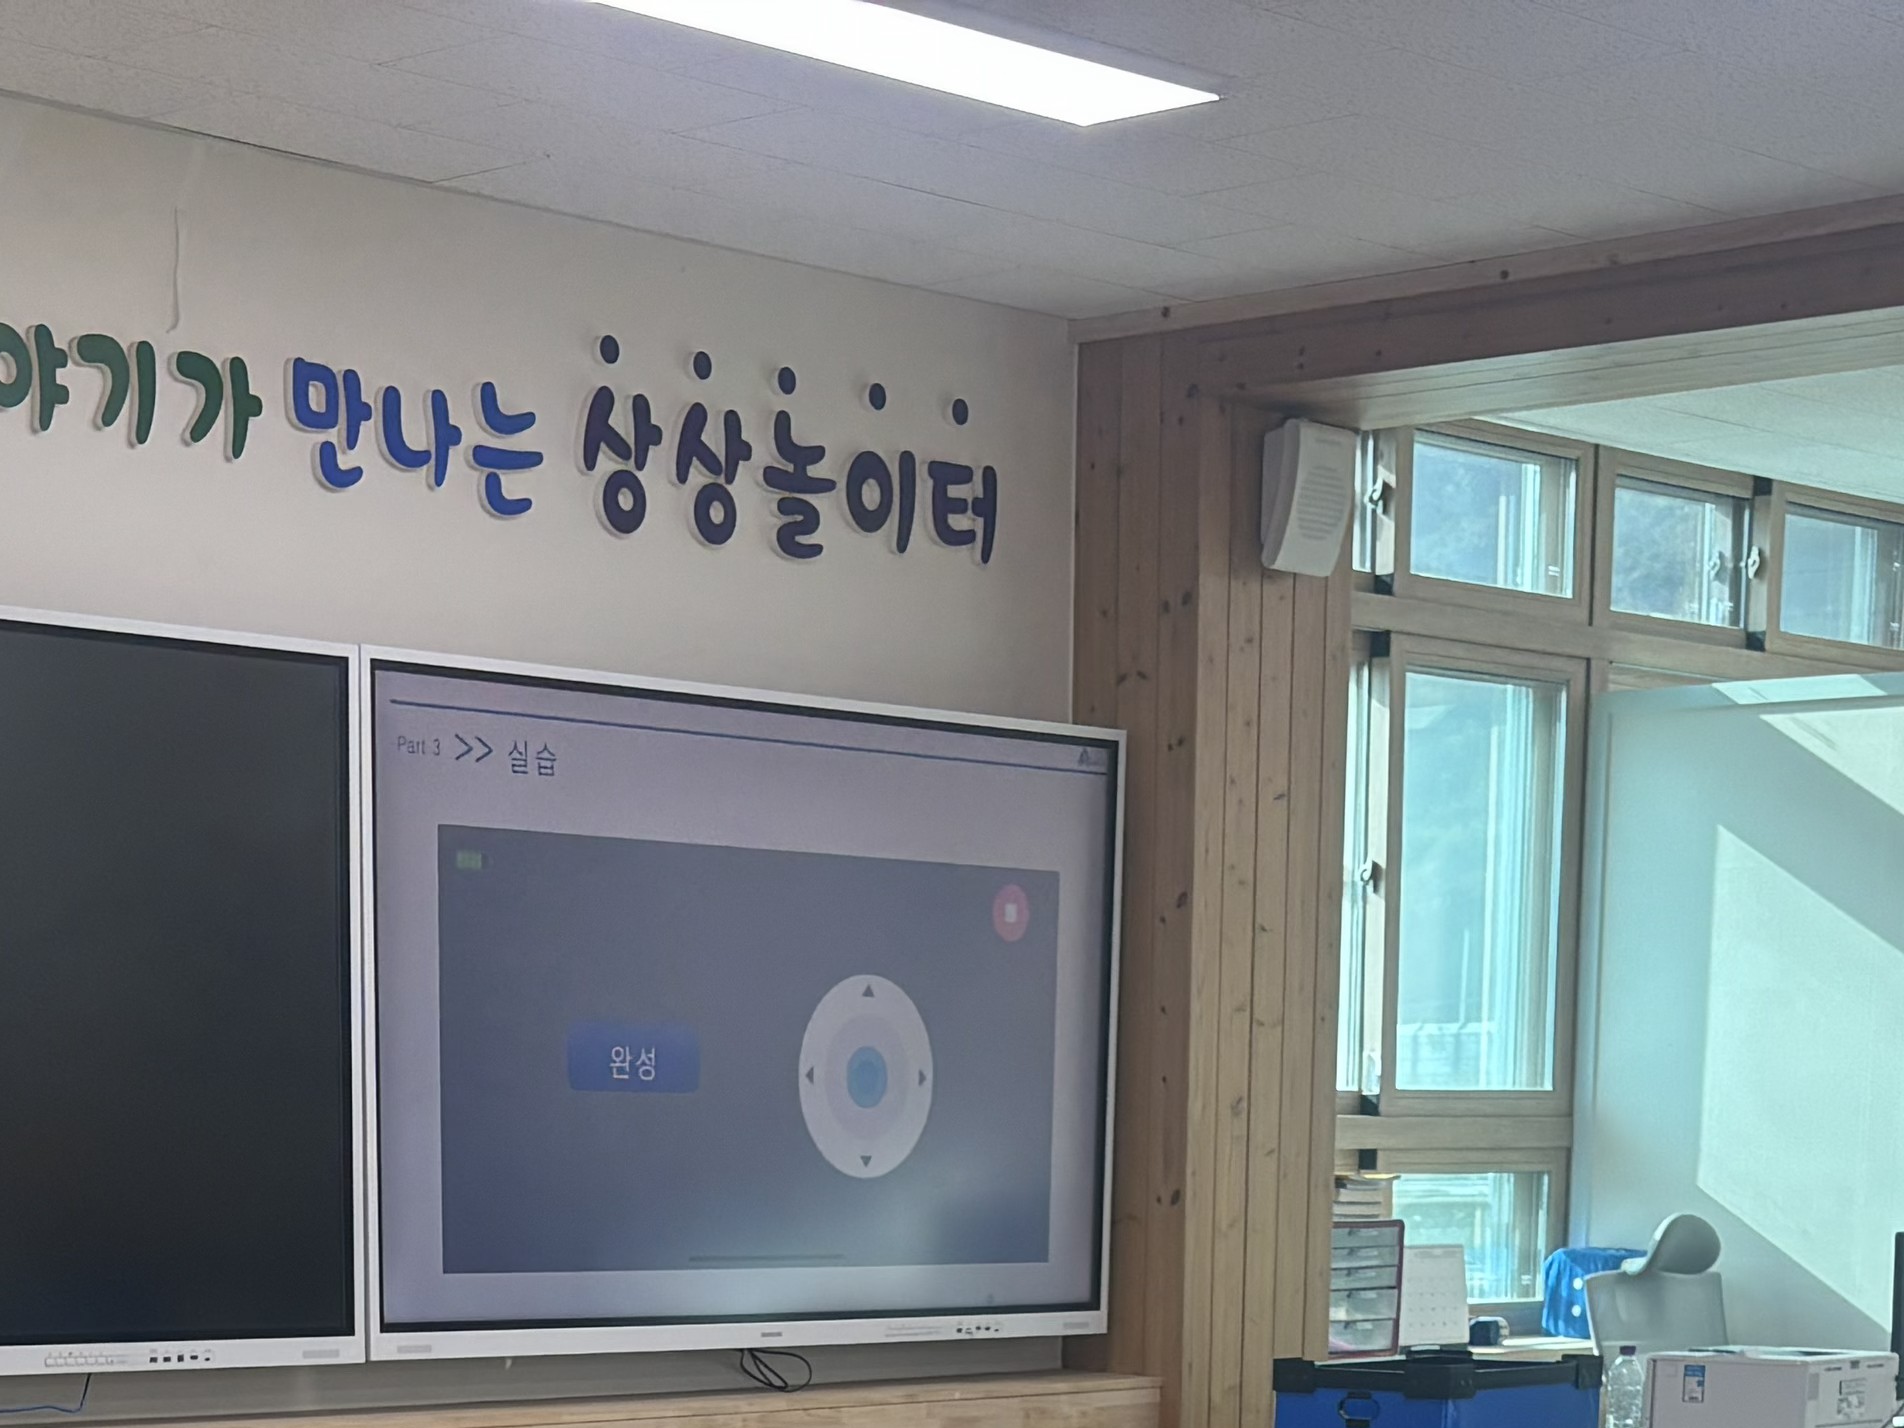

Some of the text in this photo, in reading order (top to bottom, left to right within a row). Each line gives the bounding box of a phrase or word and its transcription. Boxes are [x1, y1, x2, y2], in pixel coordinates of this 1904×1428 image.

[293, 357, 544, 516] 만나는
[583, 385, 997, 564] 상상놀이터
[397, 735, 557, 777] Part 3 실습
[609, 1045, 656, 1081] 완성
